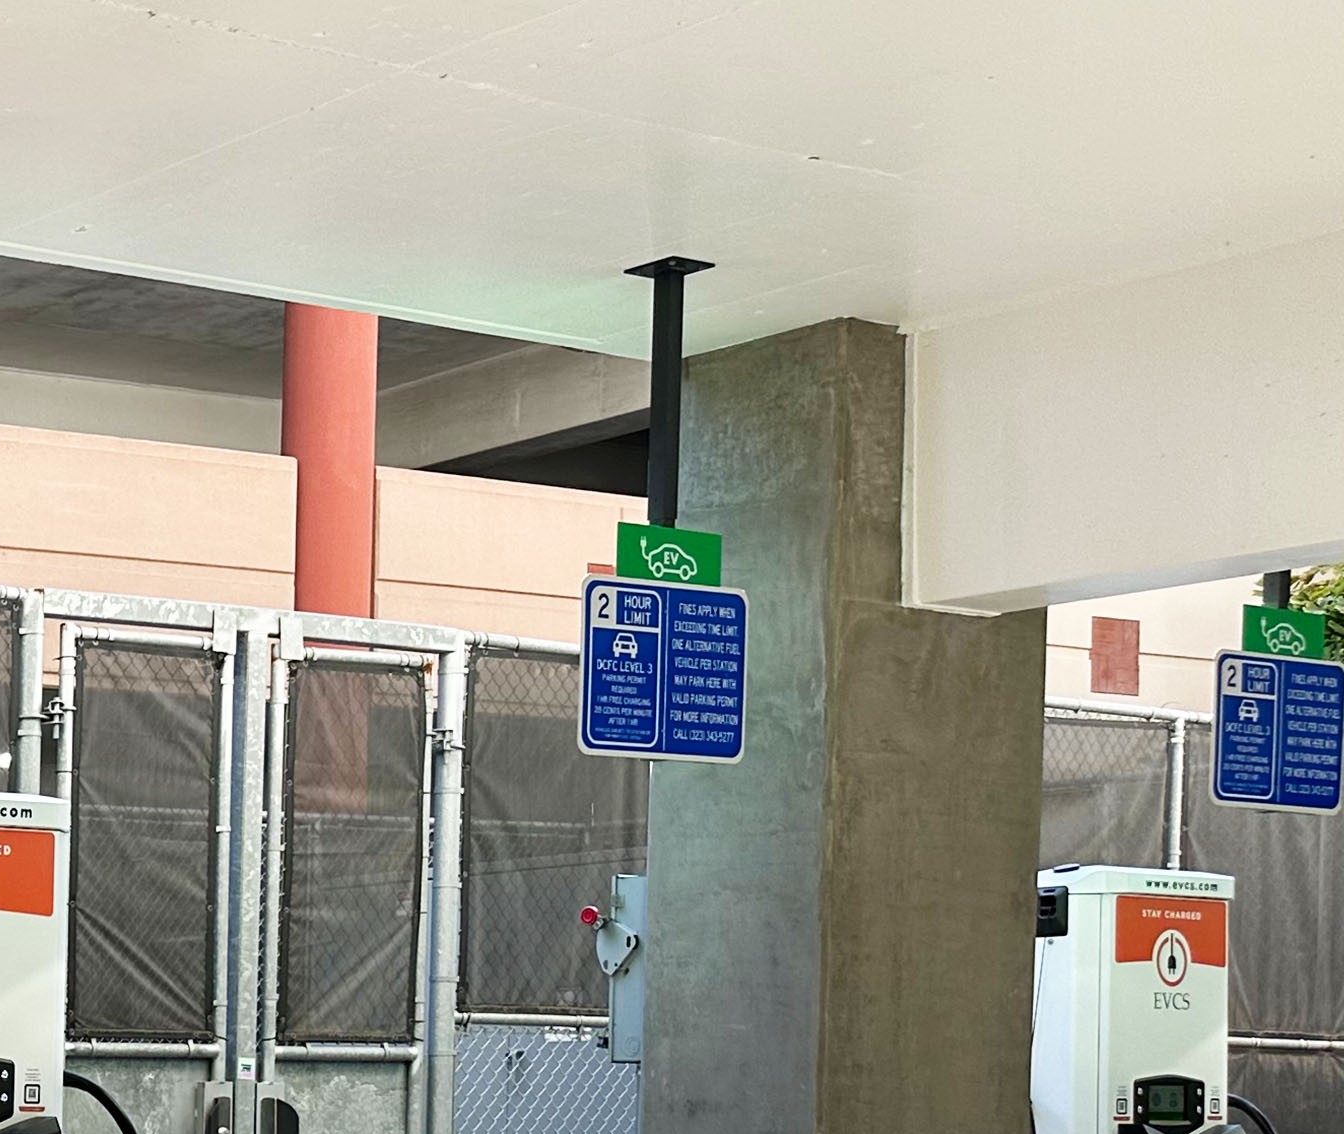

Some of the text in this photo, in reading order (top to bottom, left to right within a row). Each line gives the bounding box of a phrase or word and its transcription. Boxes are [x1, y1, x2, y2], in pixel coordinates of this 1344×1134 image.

[663, 552, 680, 565] EV
[598, 593, 610, 619] 2
[624, 595, 652, 610] HOUR
[624, 611, 651, 625] LIMIT
[597, 659, 653, 674] DCFC LEVEL 3
[1227, 665, 1236, 687] 2
[1146, 880, 1218, 892] www.evcs.com
[1141, 909, 1202, 921] STAY CHARGED
[1154, 992, 1191, 1010] EVCS
